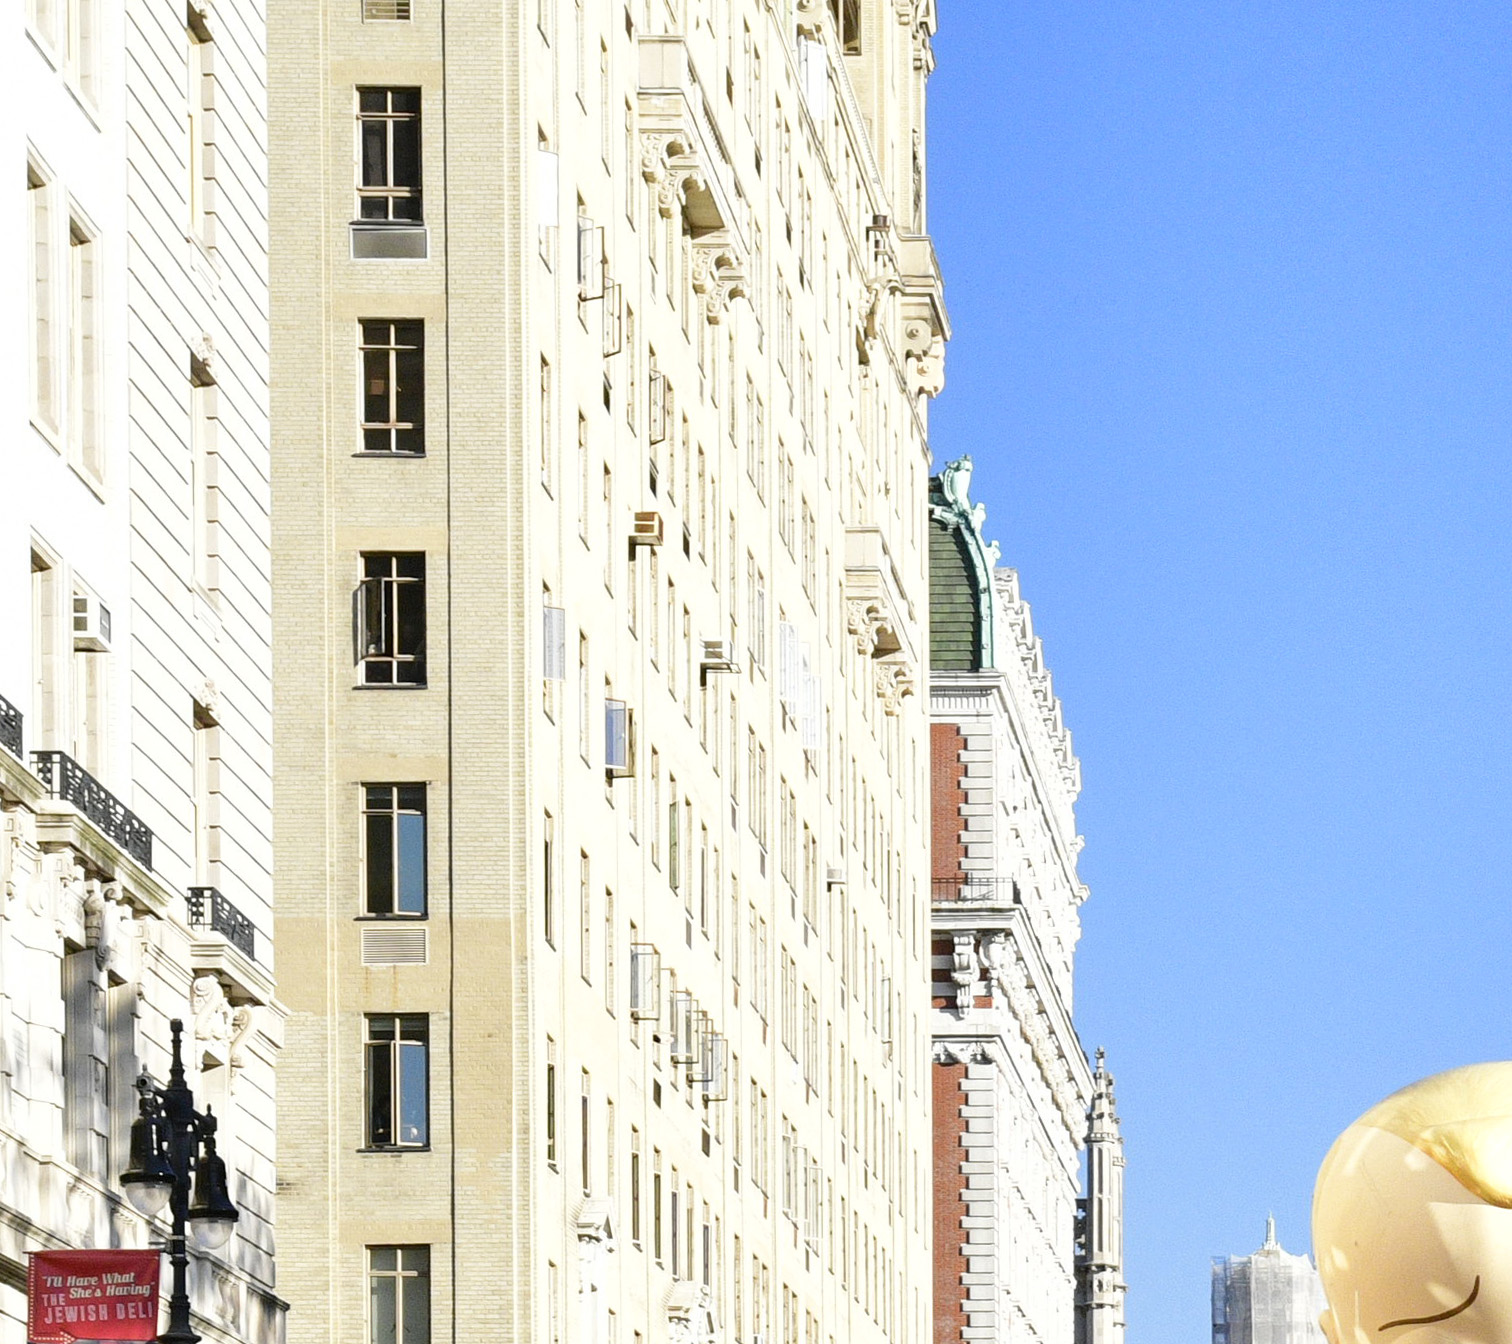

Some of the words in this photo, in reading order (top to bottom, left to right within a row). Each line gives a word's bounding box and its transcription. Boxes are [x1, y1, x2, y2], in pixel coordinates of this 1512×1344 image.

[67, 1275, 99, 1287] Have
[102, 1272, 136, 1284] What
[69, 1286, 102, 1299] She's
[41, 1293, 66, 1307] THE
[44, 1304, 108, 1324] JEWISH
[115, 1301, 153, 1320] DELI
